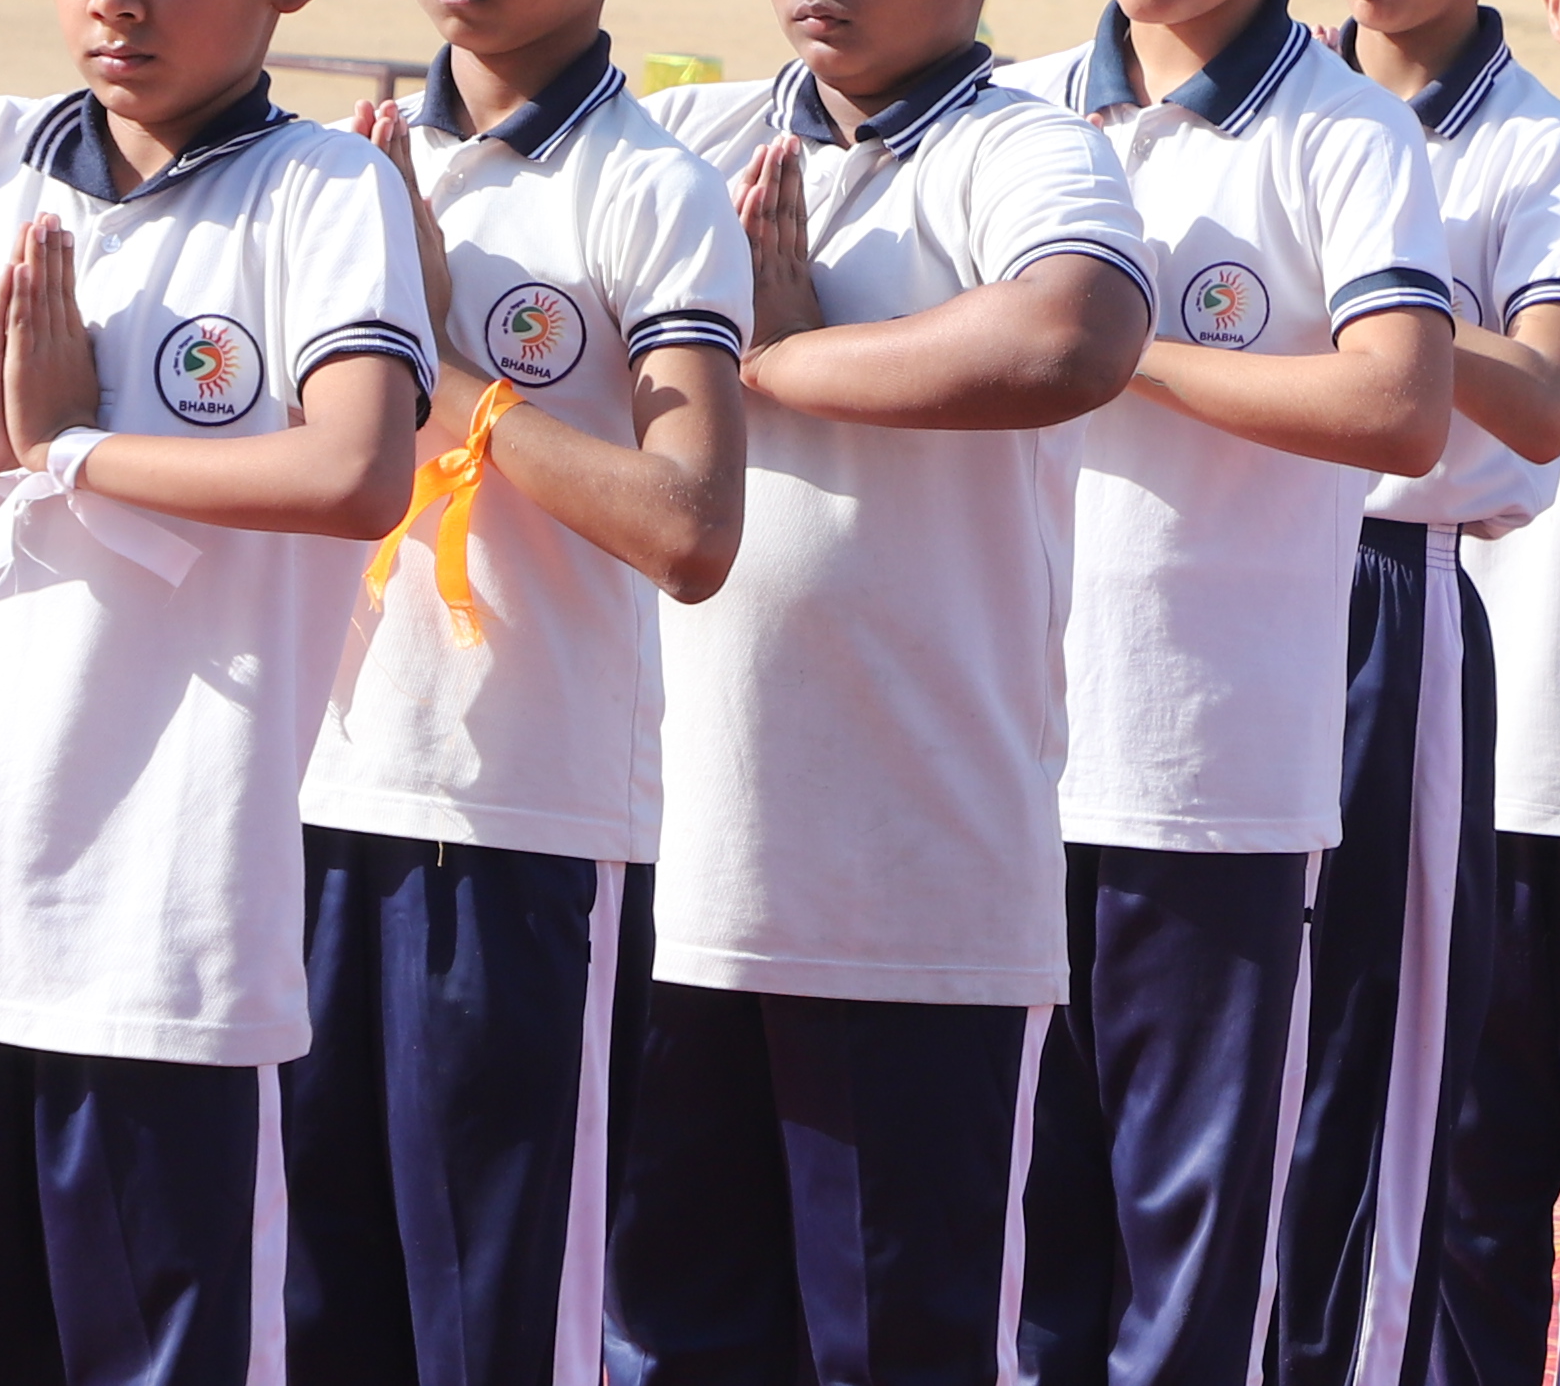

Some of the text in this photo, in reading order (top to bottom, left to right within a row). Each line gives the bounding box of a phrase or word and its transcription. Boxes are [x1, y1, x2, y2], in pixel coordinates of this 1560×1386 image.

[1199, 331, 1245, 344] BHABHA
[500, 356, 552, 379] BHABHA
[178, 399, 236, 415] BHABHA
